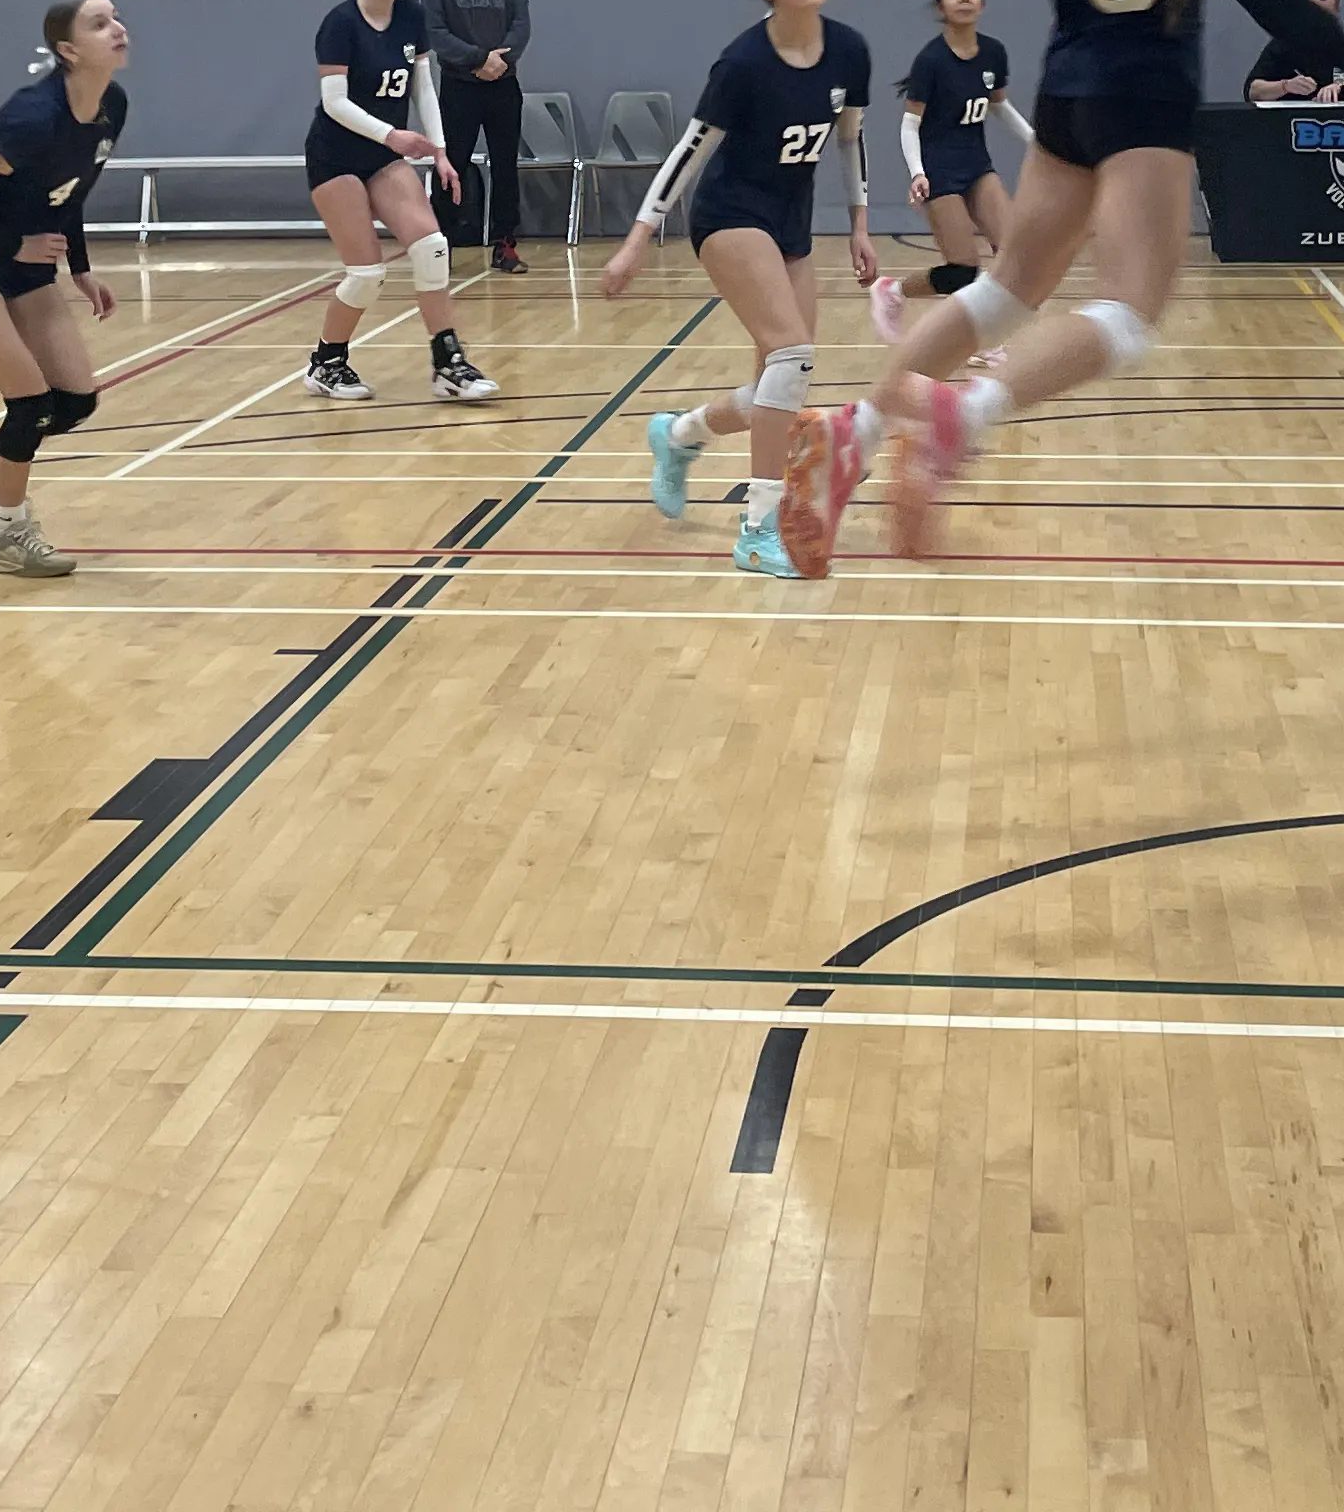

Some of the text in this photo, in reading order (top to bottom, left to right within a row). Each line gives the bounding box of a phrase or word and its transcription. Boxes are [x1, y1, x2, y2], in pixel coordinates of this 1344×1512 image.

[376, 68, 409, 98] 13
[959, 96, 989, 125] 10
[779, 122, 832, 164] 27
[48, 176, 81, 206] 4
